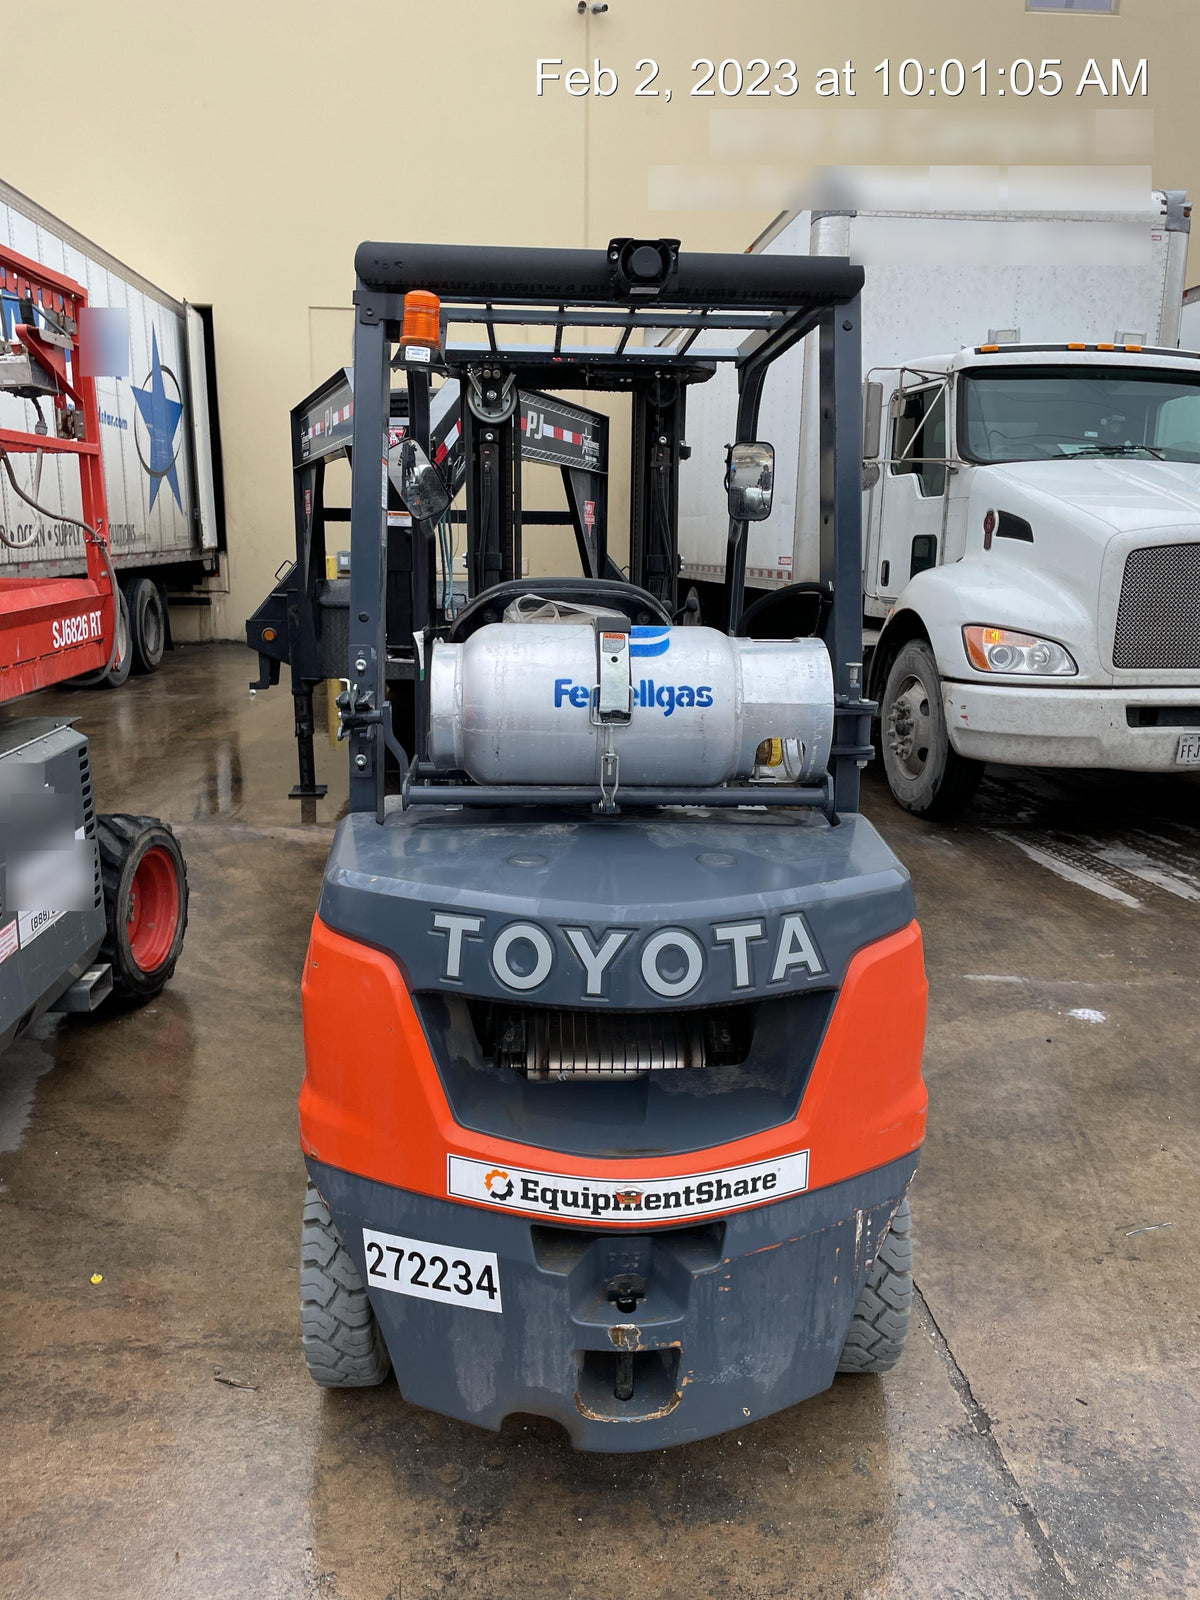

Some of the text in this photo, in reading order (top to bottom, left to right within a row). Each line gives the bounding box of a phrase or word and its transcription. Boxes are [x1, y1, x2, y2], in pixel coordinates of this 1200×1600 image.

[324, 406, 333, 437] PJ
[525, 410, 545, 440] PJ
[54, 522, 80, 547] SUPPLY
[52, 610, 102, 649] SJ6826 RT
[554, 678, 714, 717] Fellgas
[432, 913, 824, 998] TOYOTA
[366, 1241, 498, 1300] 272234
